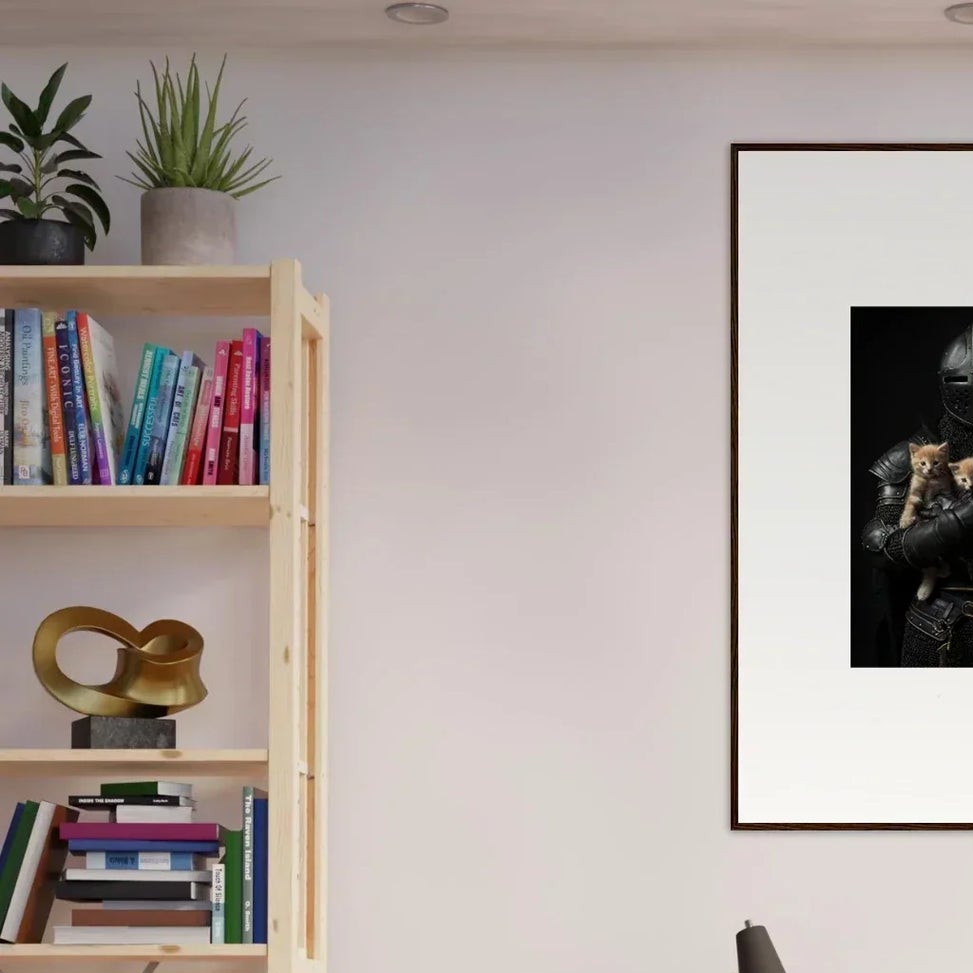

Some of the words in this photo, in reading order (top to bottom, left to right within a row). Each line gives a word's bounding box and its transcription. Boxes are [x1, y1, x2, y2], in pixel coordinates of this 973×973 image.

[22, 326, 32, 340] Oil
[19, 342, 32, 386] Paintings
[80, 327, 92, 373] Watercolor
[87, 374, 97, 411] Portraits
[59, 344, 74, 408] ICONIC
[230, 363, 240, 394] Parenting
[50, 384, 59, 401] With
[50, 402, 60, 424] Digital
[229, 395, 238, 416] Skills
[52, 425, 62, 442] Tools
